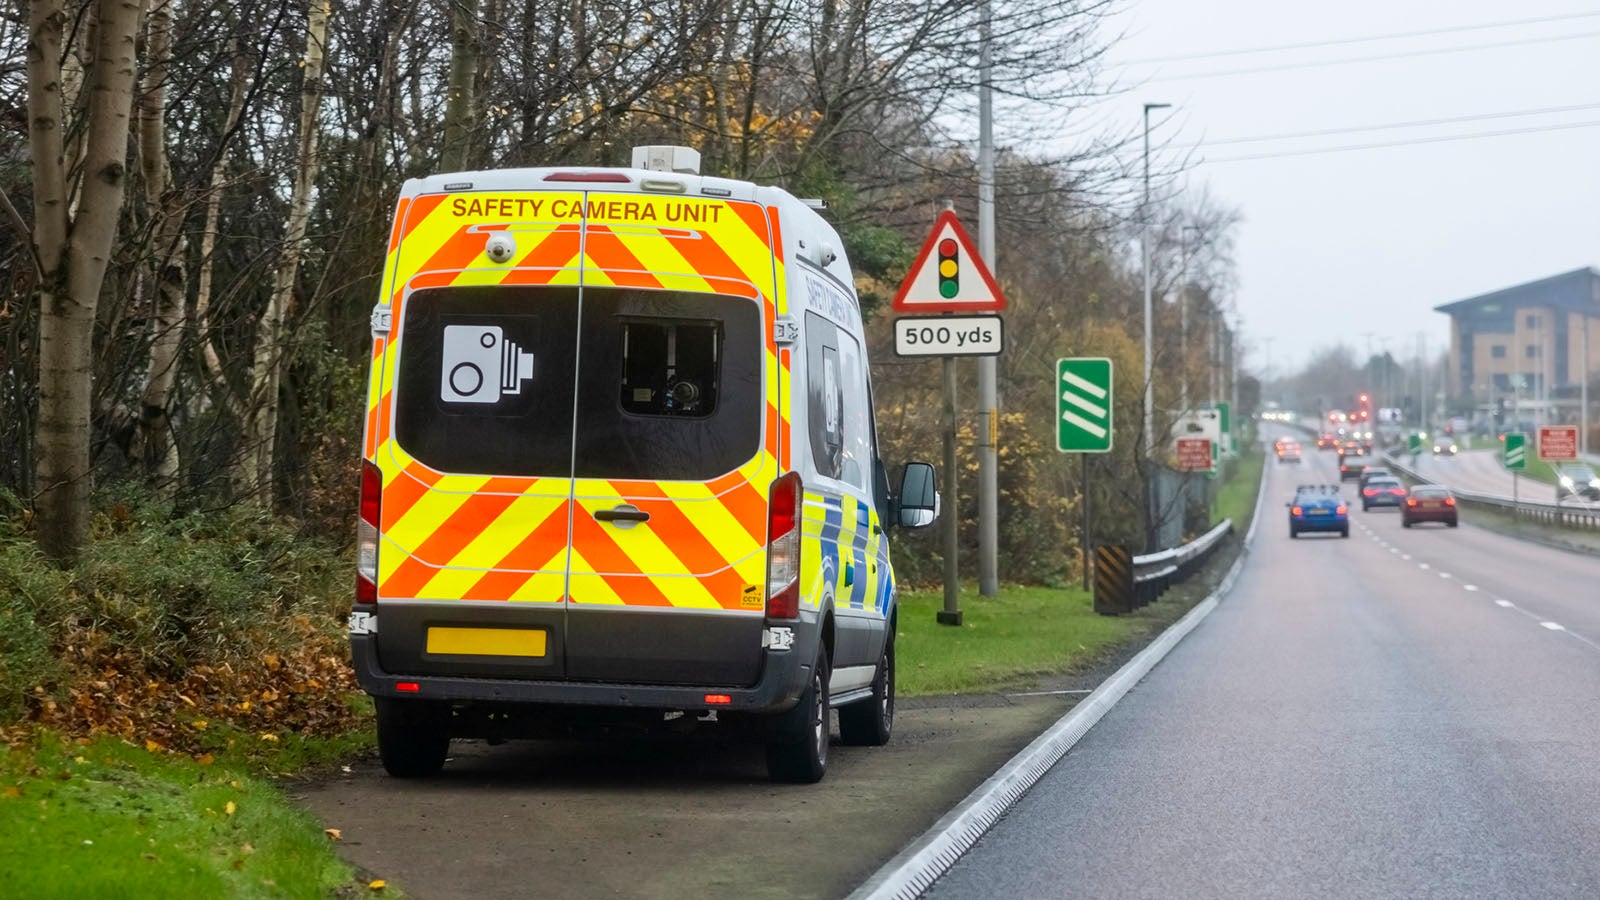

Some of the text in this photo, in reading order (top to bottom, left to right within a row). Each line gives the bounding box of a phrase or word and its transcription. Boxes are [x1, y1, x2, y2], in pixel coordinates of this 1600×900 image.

[452, 198, 724, 224] SAFETY CAMERA UNIT
[906, 326, 993, 347] 500 yds
